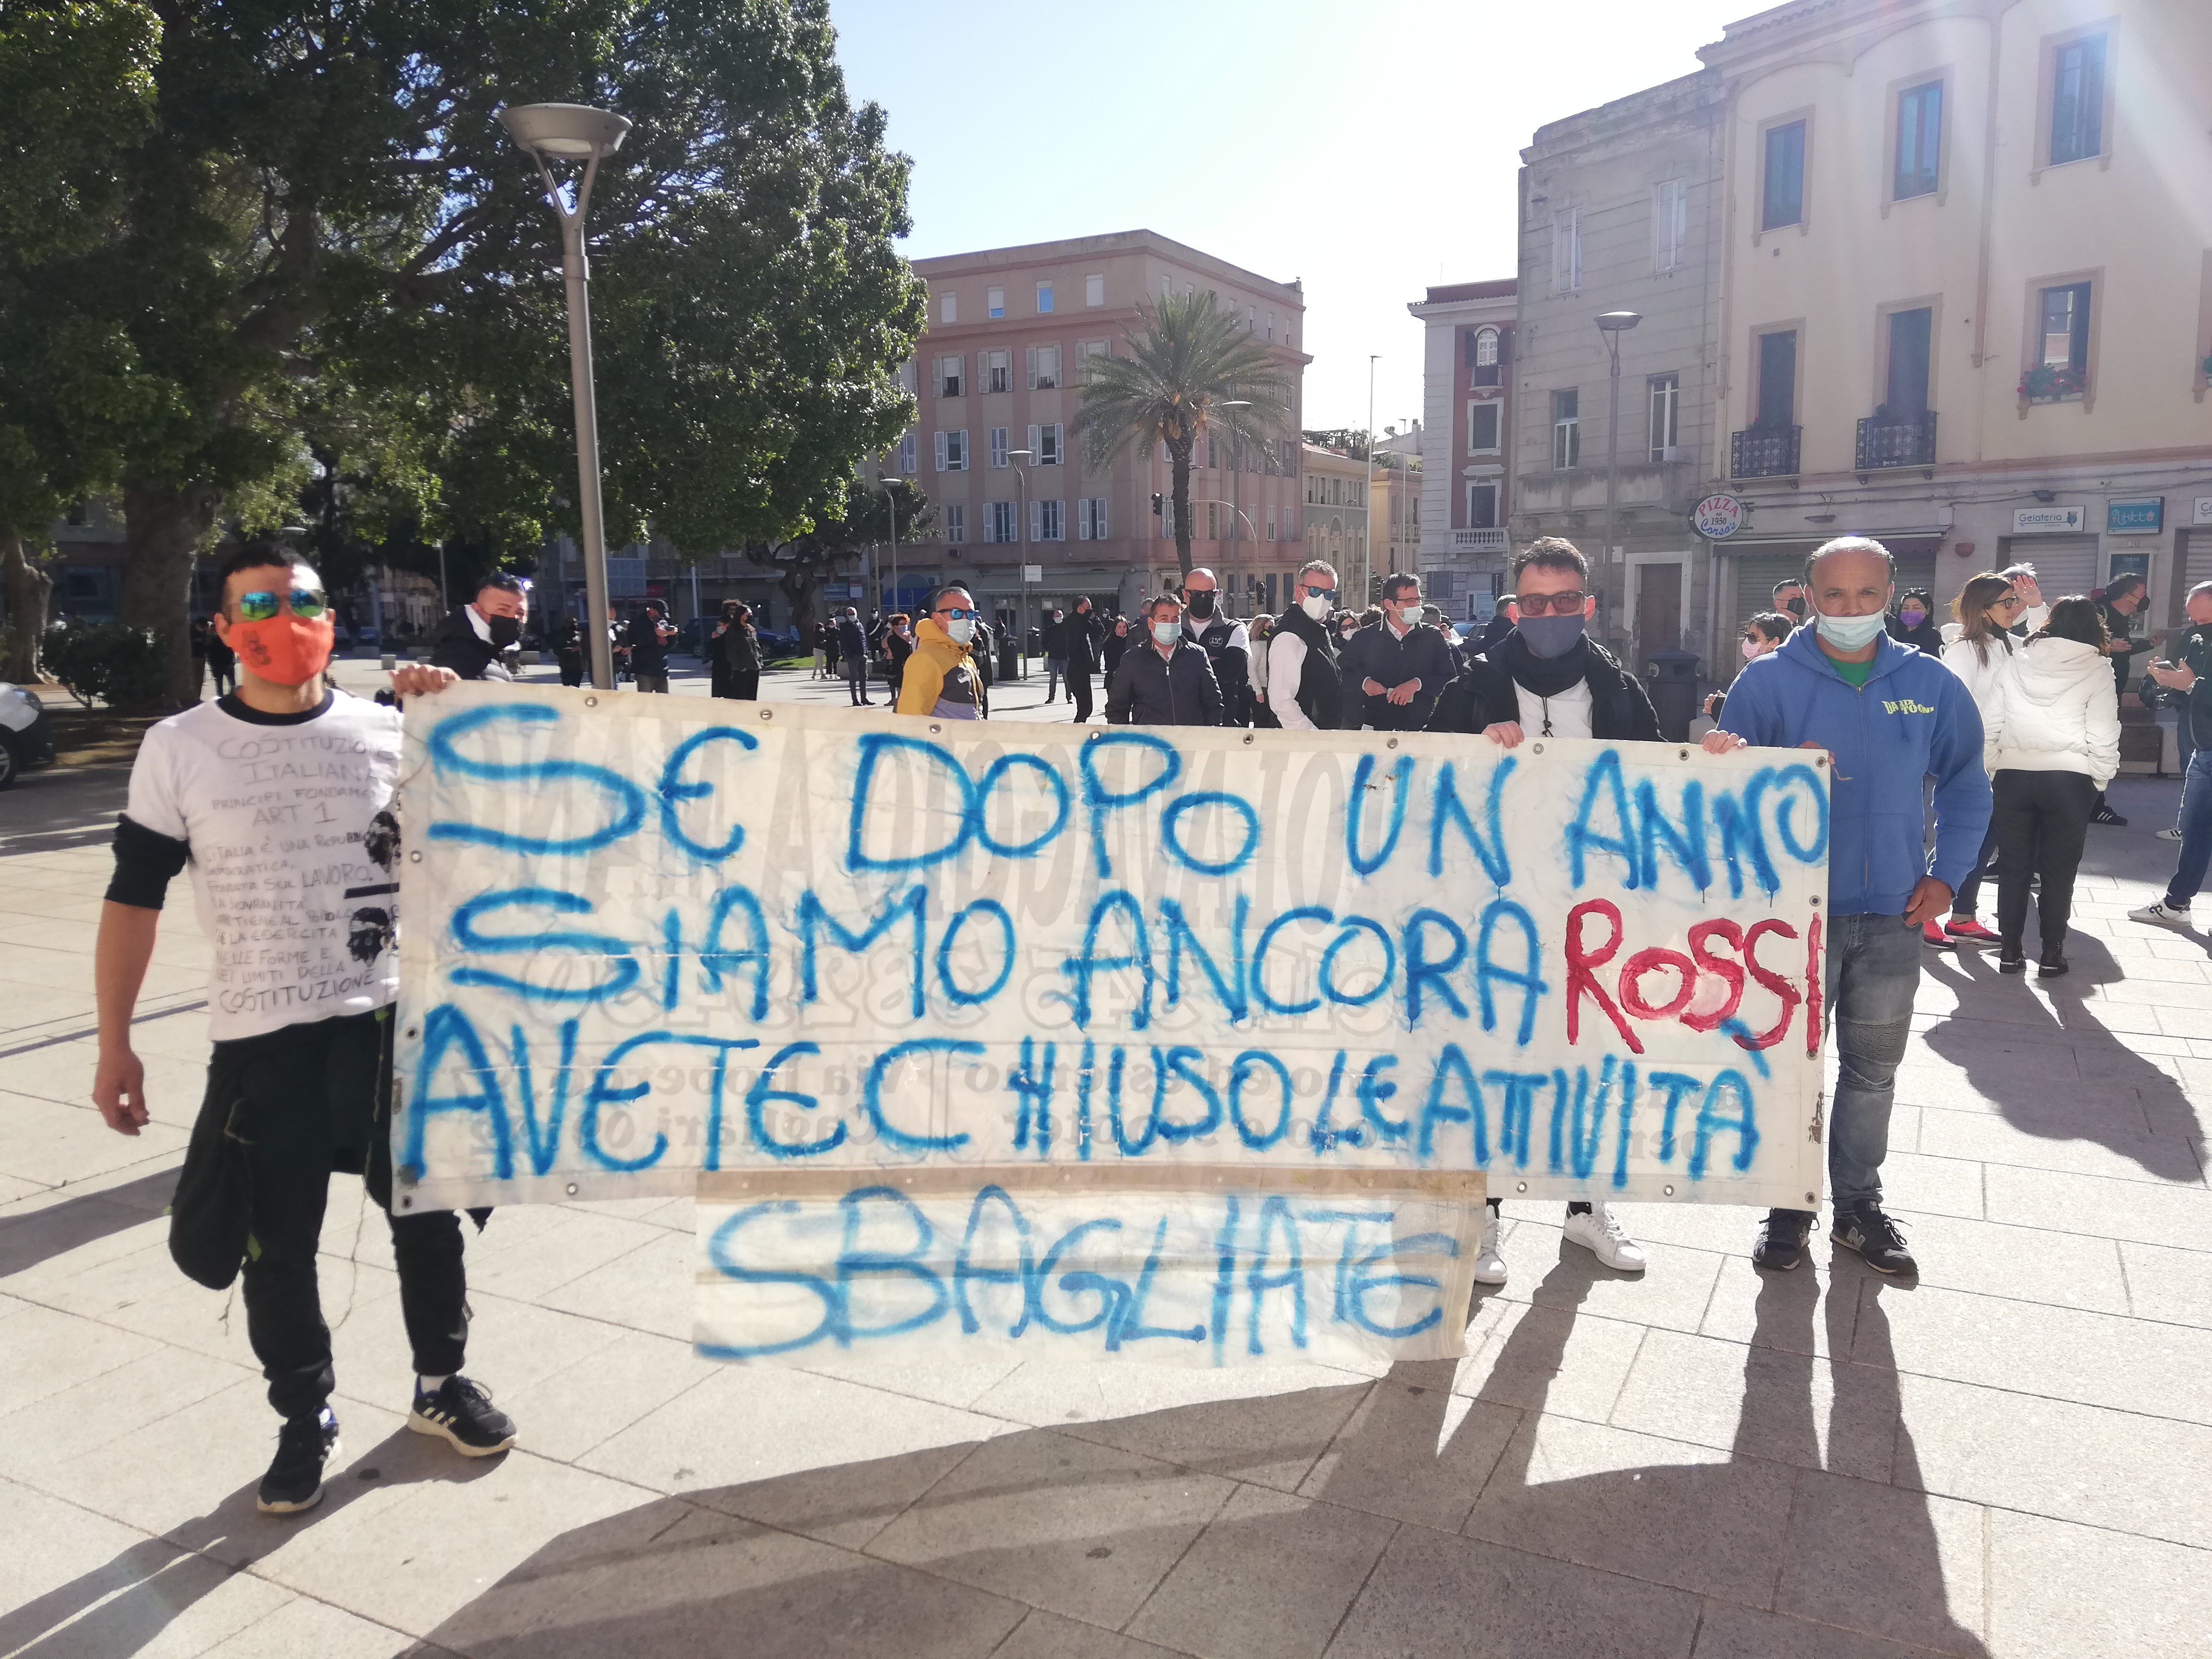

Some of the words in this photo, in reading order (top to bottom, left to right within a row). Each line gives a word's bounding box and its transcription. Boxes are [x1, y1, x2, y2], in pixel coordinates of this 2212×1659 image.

[1698, 497, 1738, 518] PIZZA
[1700, 518, 1736, 535] Corso's
[2019, 513, 2062, 522] Gelateria
[253, 805, 302, 828] ART
[314, 801, 338, 824] 1
[427, 702, 757, 861] SE
[846, 731, 1262, 877] DOPO
[1345, 754, 1518, 887] UN
[1565, 748, 1830, 900] ANNO
[219, 968, 374, 1013] COSTITUZIONE
[450, 884, 1017, 1022] SIAMO
[1060, 890, 1549, 1047] ANCORA
[1564, 898, 1824, 1054] ROSSI
[400, 1002, 846, 1182] AVETE
[866, 1034, 1293, 1161] CHIUSO
[1310, 1050, 1410, 1159] LE
[695, 1185, 1457, 1366] SBAGLIATE
